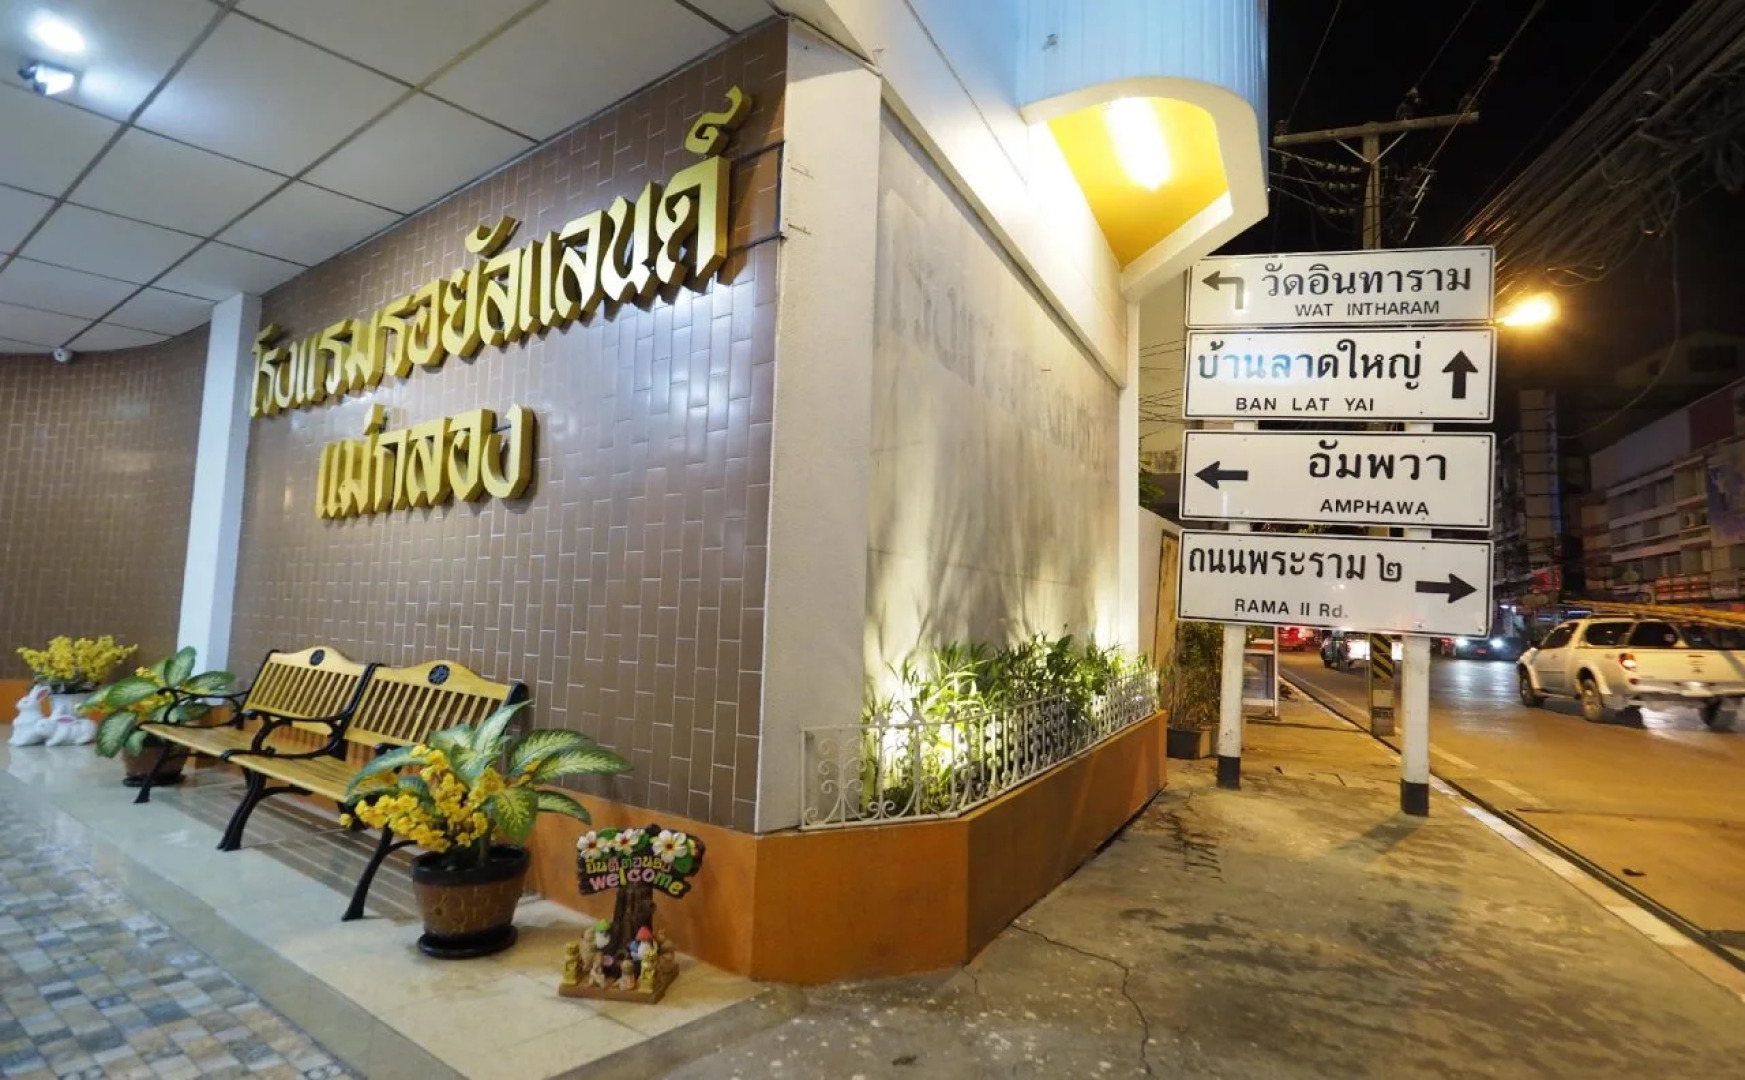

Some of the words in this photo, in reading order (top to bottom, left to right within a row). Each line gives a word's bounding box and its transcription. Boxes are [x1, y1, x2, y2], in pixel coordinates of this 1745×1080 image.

[1261, 261, 1472, 297] วัดอินทาราม
[1295, 302, 1334, 317] WAT
[1347, 299, 1440, 317] INTHARAM
[1197, 338, 1422, 391] บ้านลาดใหญ่
[1235, 396, 1278, 412] BAN
[1292, 396, 1330, 412] LAT
[1344, 397, 1375, 412] YAI
[316, 402, 540, 520] แม่กลอง
[1309, 438, 1447, 481] อัมพวา
[1319, 498, 1430, 516] AMPHAWA
[1188, 547, 1366, 580] ถนนพระราม
[1376, 553, 1402, 582] ๒
[1234, 598, 1290, 616] RAMA
[1299, 602, 1311, 617] II
[1318, 603, 1348, 619] Rd.
[589, 868, 684, 895] welcome
